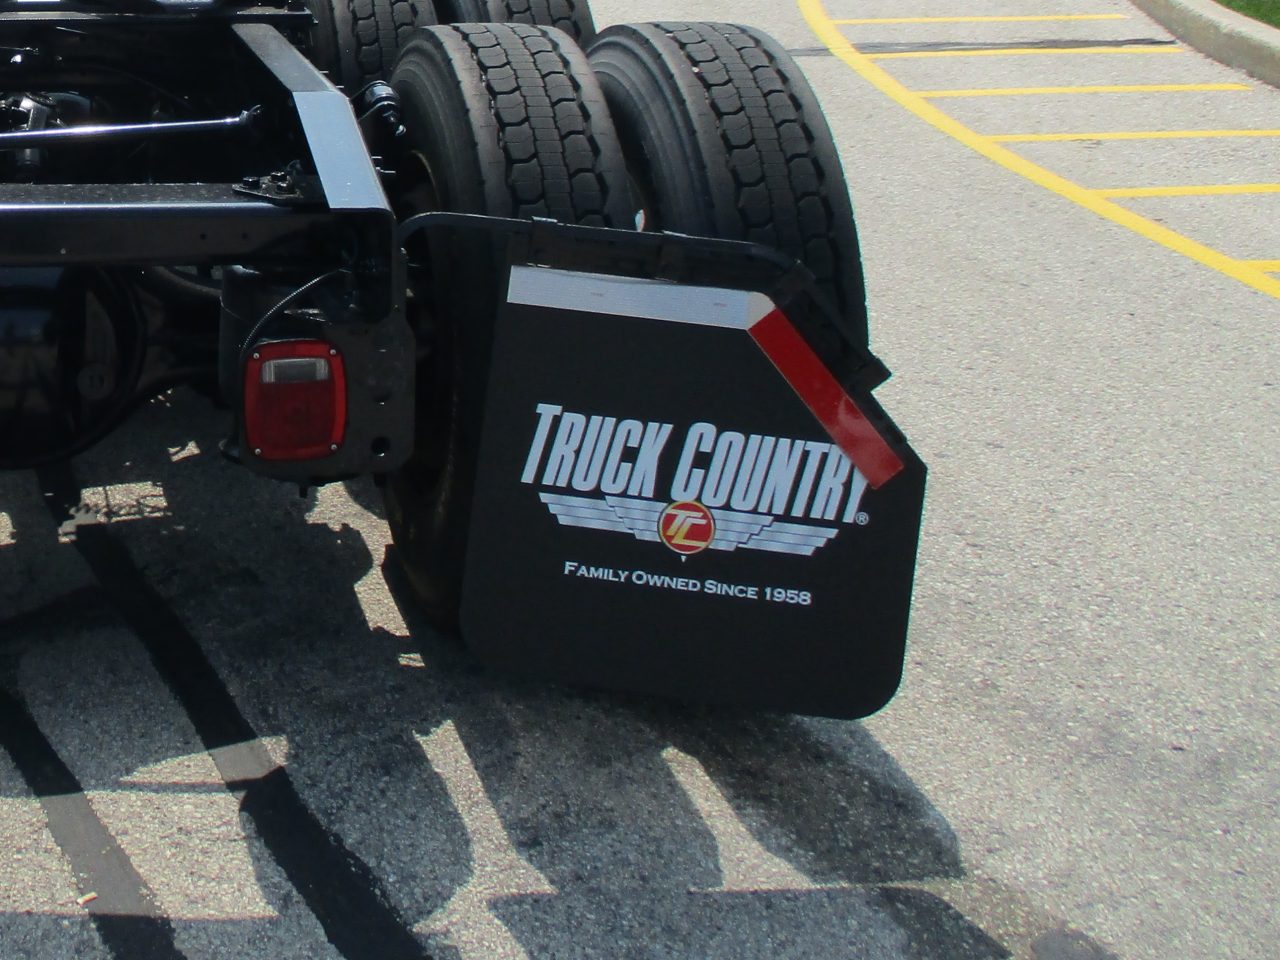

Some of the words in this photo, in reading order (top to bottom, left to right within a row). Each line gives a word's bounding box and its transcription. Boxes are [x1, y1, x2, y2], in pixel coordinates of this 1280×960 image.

[521, 403, 674, 498] TRUCK
[670, 422, 869, 524] COUNTRY
[564, 561, 630, 584] FAMILY
[631, 570, 701, 593] OWNED
[704, 579, 758, 601] SINCE
[763, 586, 812, 606] 1958
